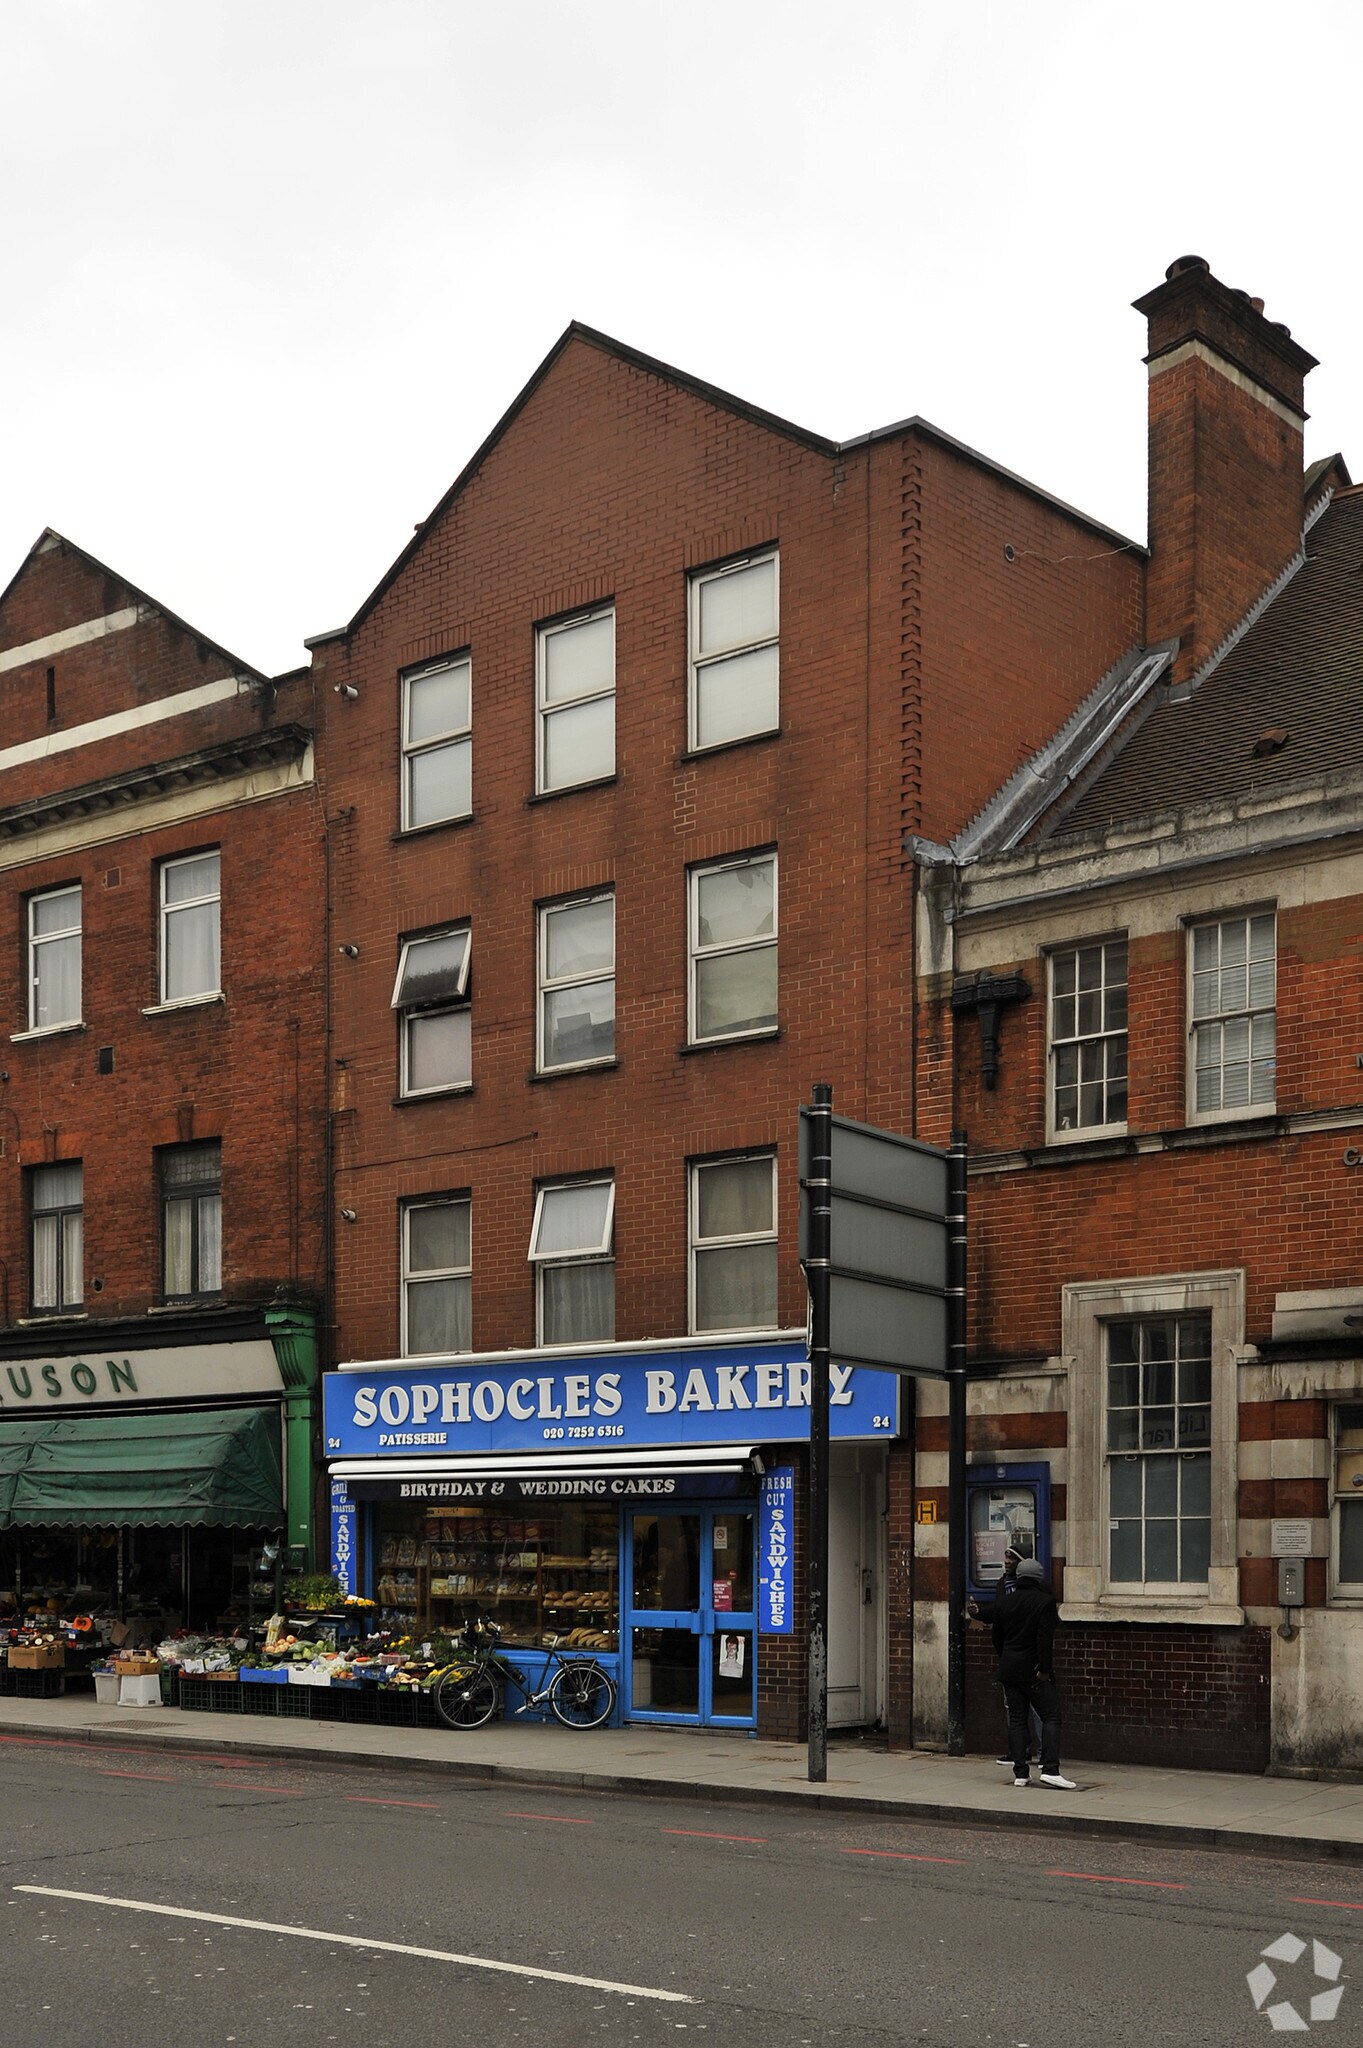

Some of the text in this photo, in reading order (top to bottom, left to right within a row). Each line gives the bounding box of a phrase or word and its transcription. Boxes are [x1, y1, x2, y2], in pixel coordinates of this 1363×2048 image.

[0, 1359, 138, 1400] USON
[353, 1362, 853, 1427] SOPHOCLES BAKERY
[873, 1416, 890, 1428] 24
[379, 1432, 448, 1446] PATISSERIE
[543, 1427, 564, 1439] 020
[567, 1426, 595, 1438] 7252
[328, 1438, 341, 1449] 24
[399, 1477, 676, 1499] BIRTHDAY & WEDDING CAKES
[761, 1476, 792, 1490] FRESH
[766, 1493, 786, 1506] CUT
[331, 1504, 356, 1513] TOASTED
[920, 1502, 934, 1522] H
[769, 1509, 789, 1627] SANDWICHES
